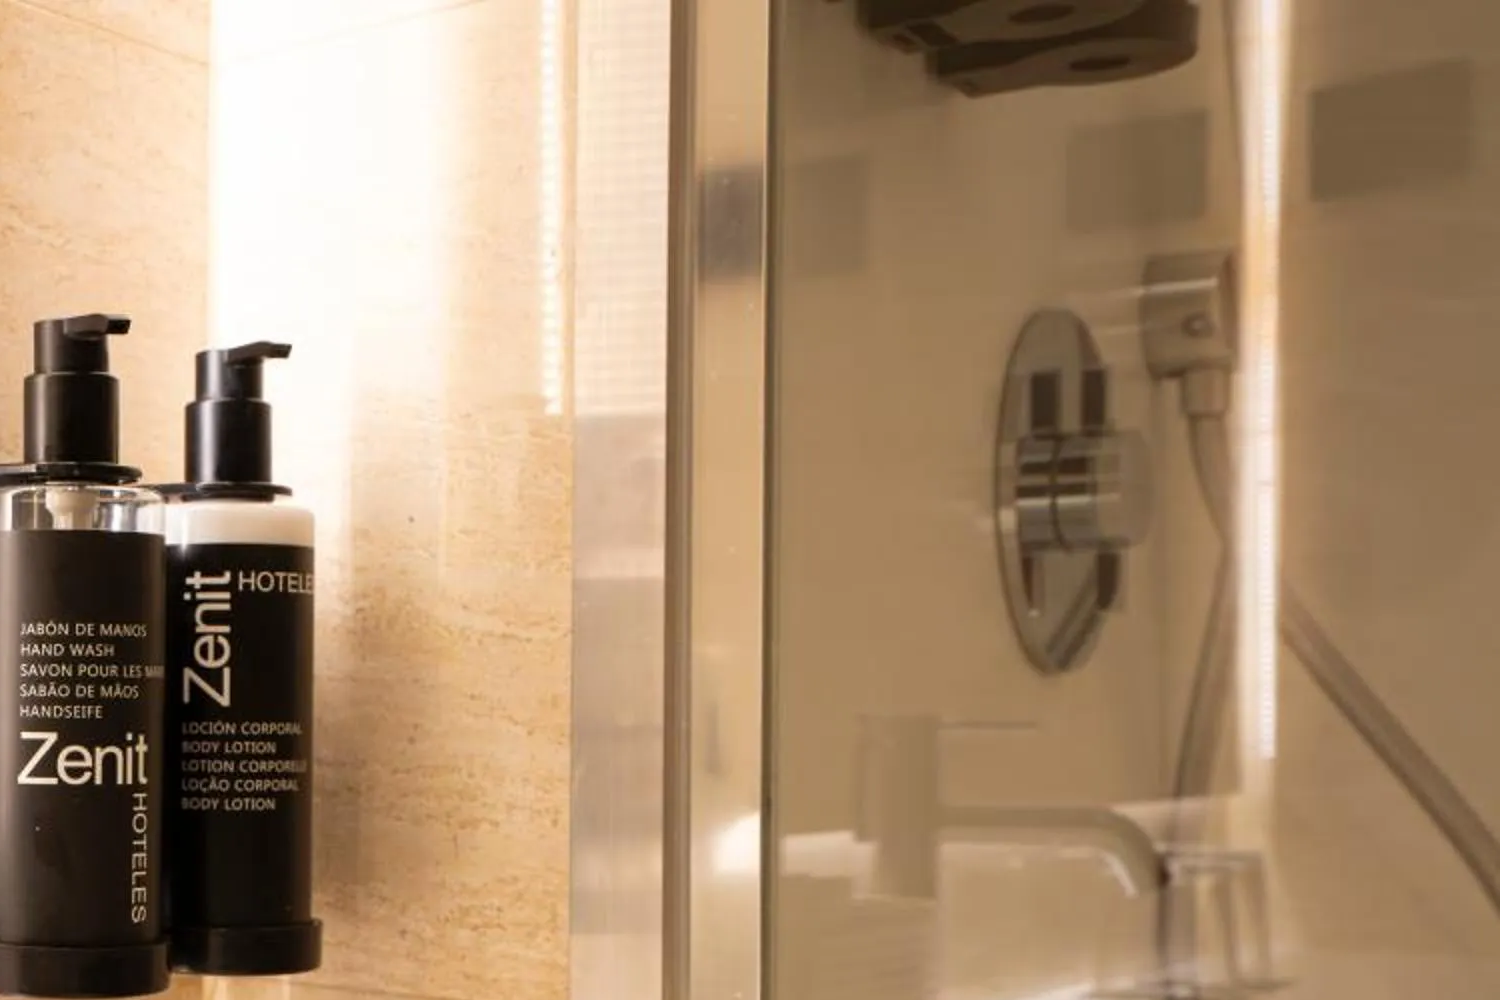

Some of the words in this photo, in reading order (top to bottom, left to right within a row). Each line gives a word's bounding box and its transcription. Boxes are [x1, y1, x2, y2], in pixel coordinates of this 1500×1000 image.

[20, 620, 69, 636] JABÓN
[75, 623, 95, 636] DE
[99, 623, 147, 638] MANOS
[183, 570, 231, 707] Zenit
[20, 643, 65, 656] HAND
[69, 643, 115, 657] WASH
[19, 663, 73, 677] SAVON
[77, 664, 118, 678] POUR
[123, 665, 142, 678] LES
[19, 681, 70, 698] SABÃO
[75, 685, 95, 698] DE
[100, 683, 140, 699] MÃOS
[19, 705, 104, 719] HANDSEIFE
[182, 720, 237, 735] LOCIÓN
[182, 741, 220, 753] BODY
[224, 741, 277, 753] LOTION
[17, 731, 148, 785] Zenit
[182, 760, 235, 773] LOTION
[182, 775, 231, 793] LOÇÃO
[181, 797, 219, 810] BODY
[224, 798, 276, 811] LOTION
[132, 792, 148, 923] HOTELES
